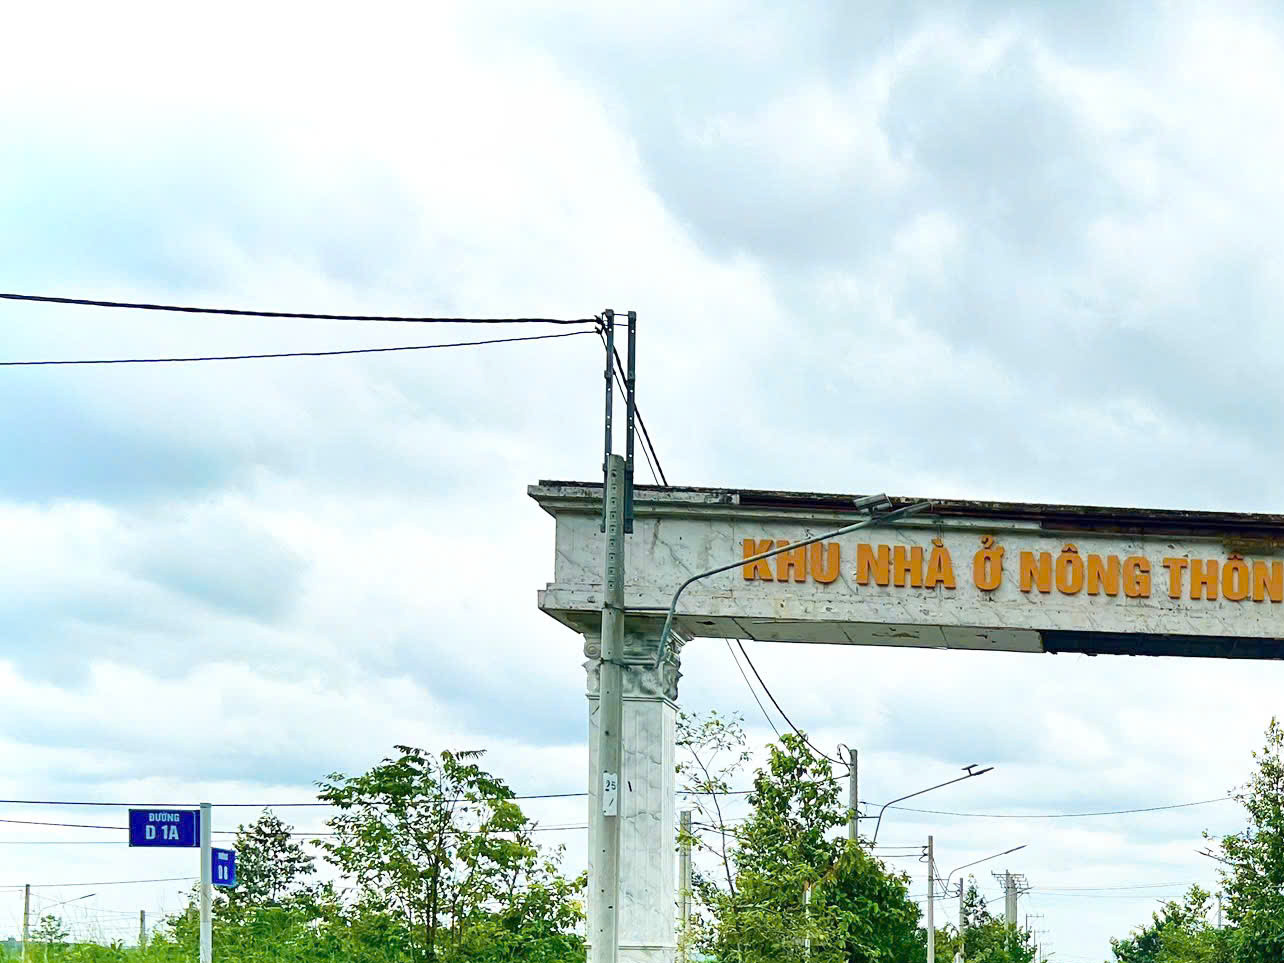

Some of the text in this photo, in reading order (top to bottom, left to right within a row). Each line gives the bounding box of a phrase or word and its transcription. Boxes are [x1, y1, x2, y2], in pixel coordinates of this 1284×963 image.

[742, 538, 841, 584] KHU
[855, 536, 957, 590] NHÀ
[973, 534, 1006, 592] Ở
[1019, 543, 1152, 598] NÔNG
[1163, 552, 1284, 603] THÔN
[149, 812, 180, 822] ĐƯỜNG
[145, 825, 179, 840] D 1A
